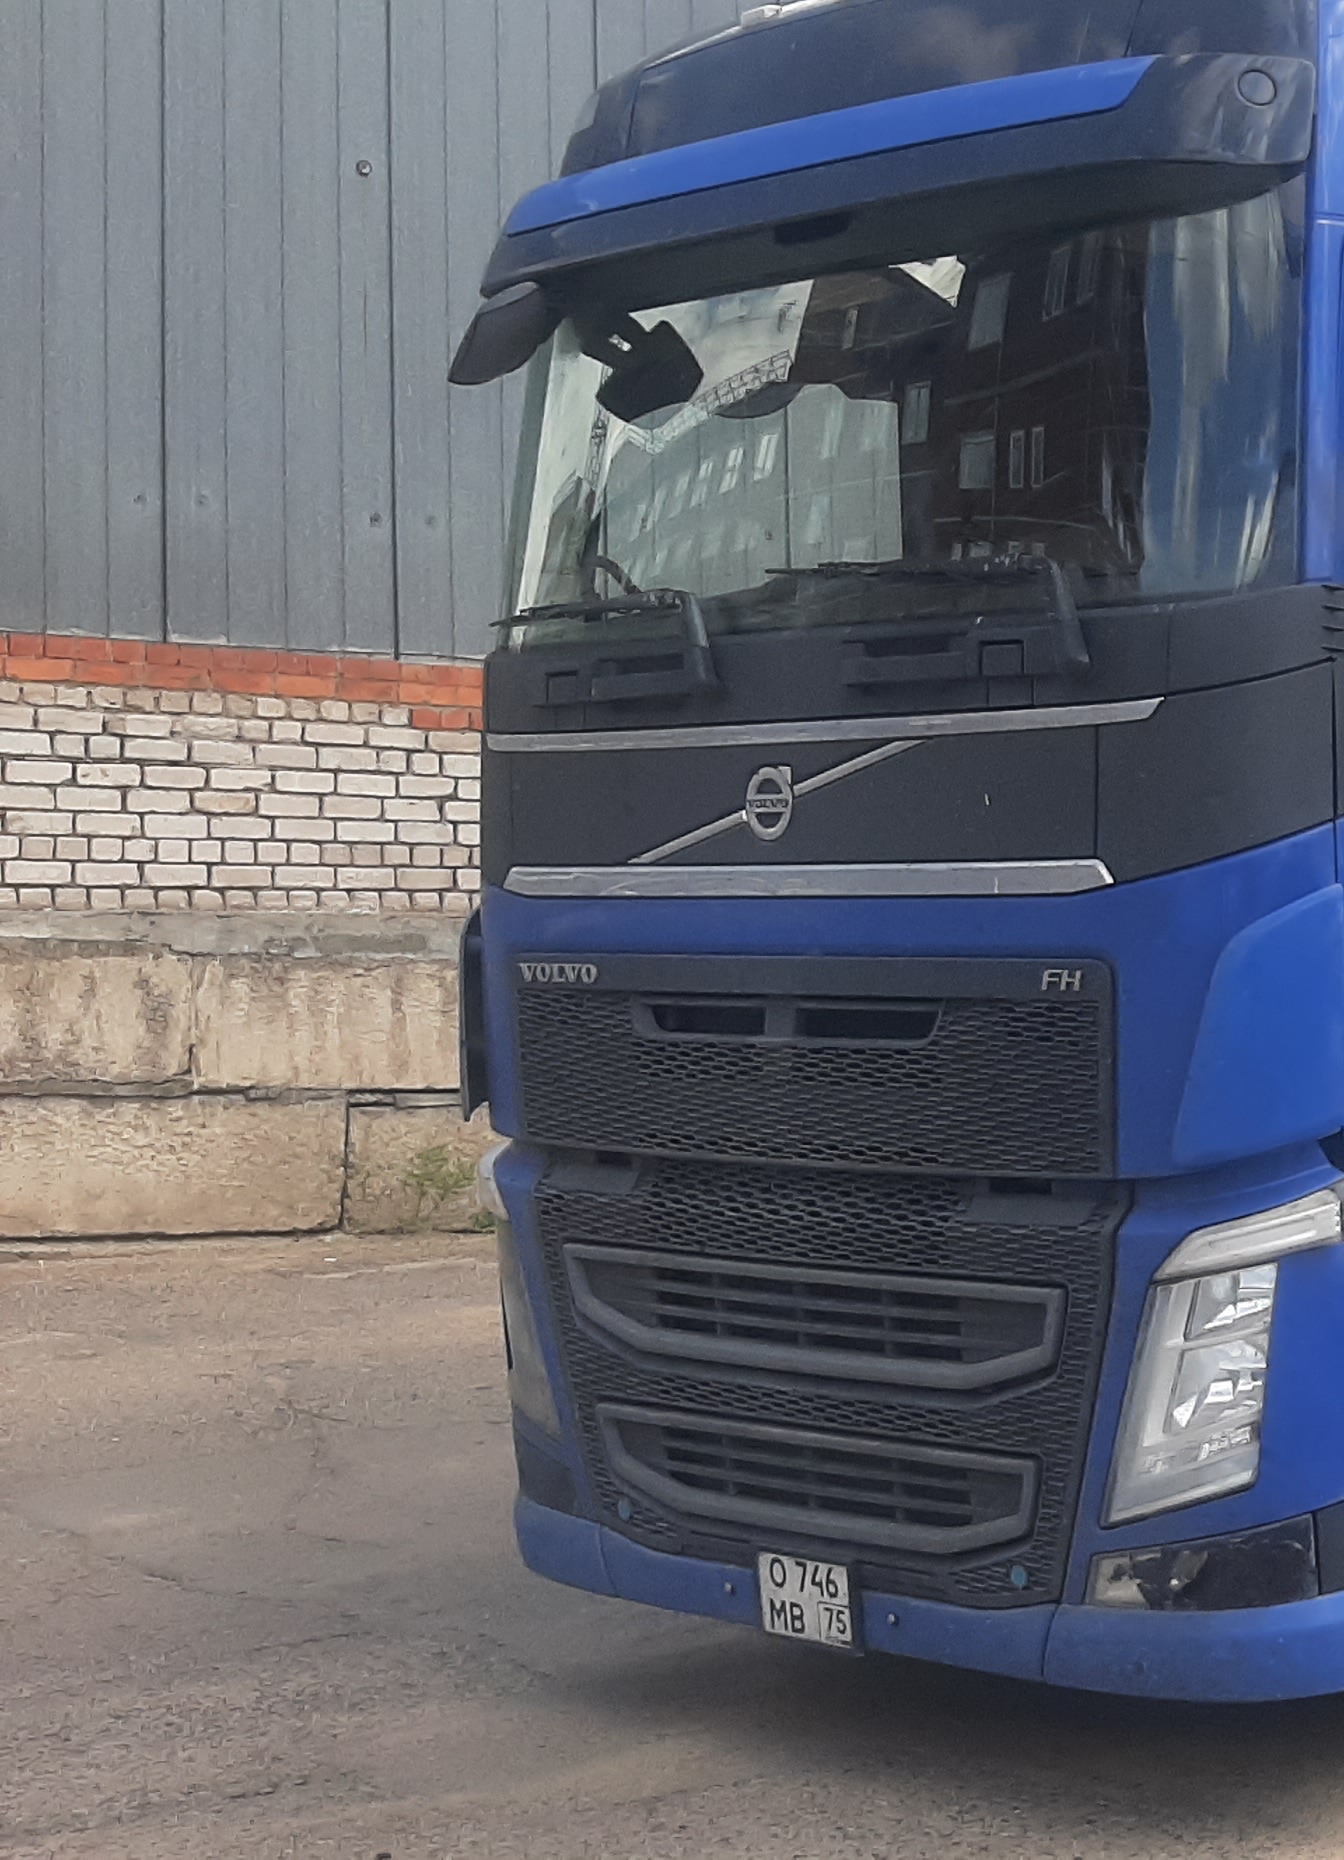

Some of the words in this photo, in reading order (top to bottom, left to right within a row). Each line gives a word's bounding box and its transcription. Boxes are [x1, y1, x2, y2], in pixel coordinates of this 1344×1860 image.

[518, 963, 597, 984] VOLVO
[1041, 969, 1082, 991] FH
[794, 1560, 839, 1599] 746
[822, 1606, 847, 1636] 75
